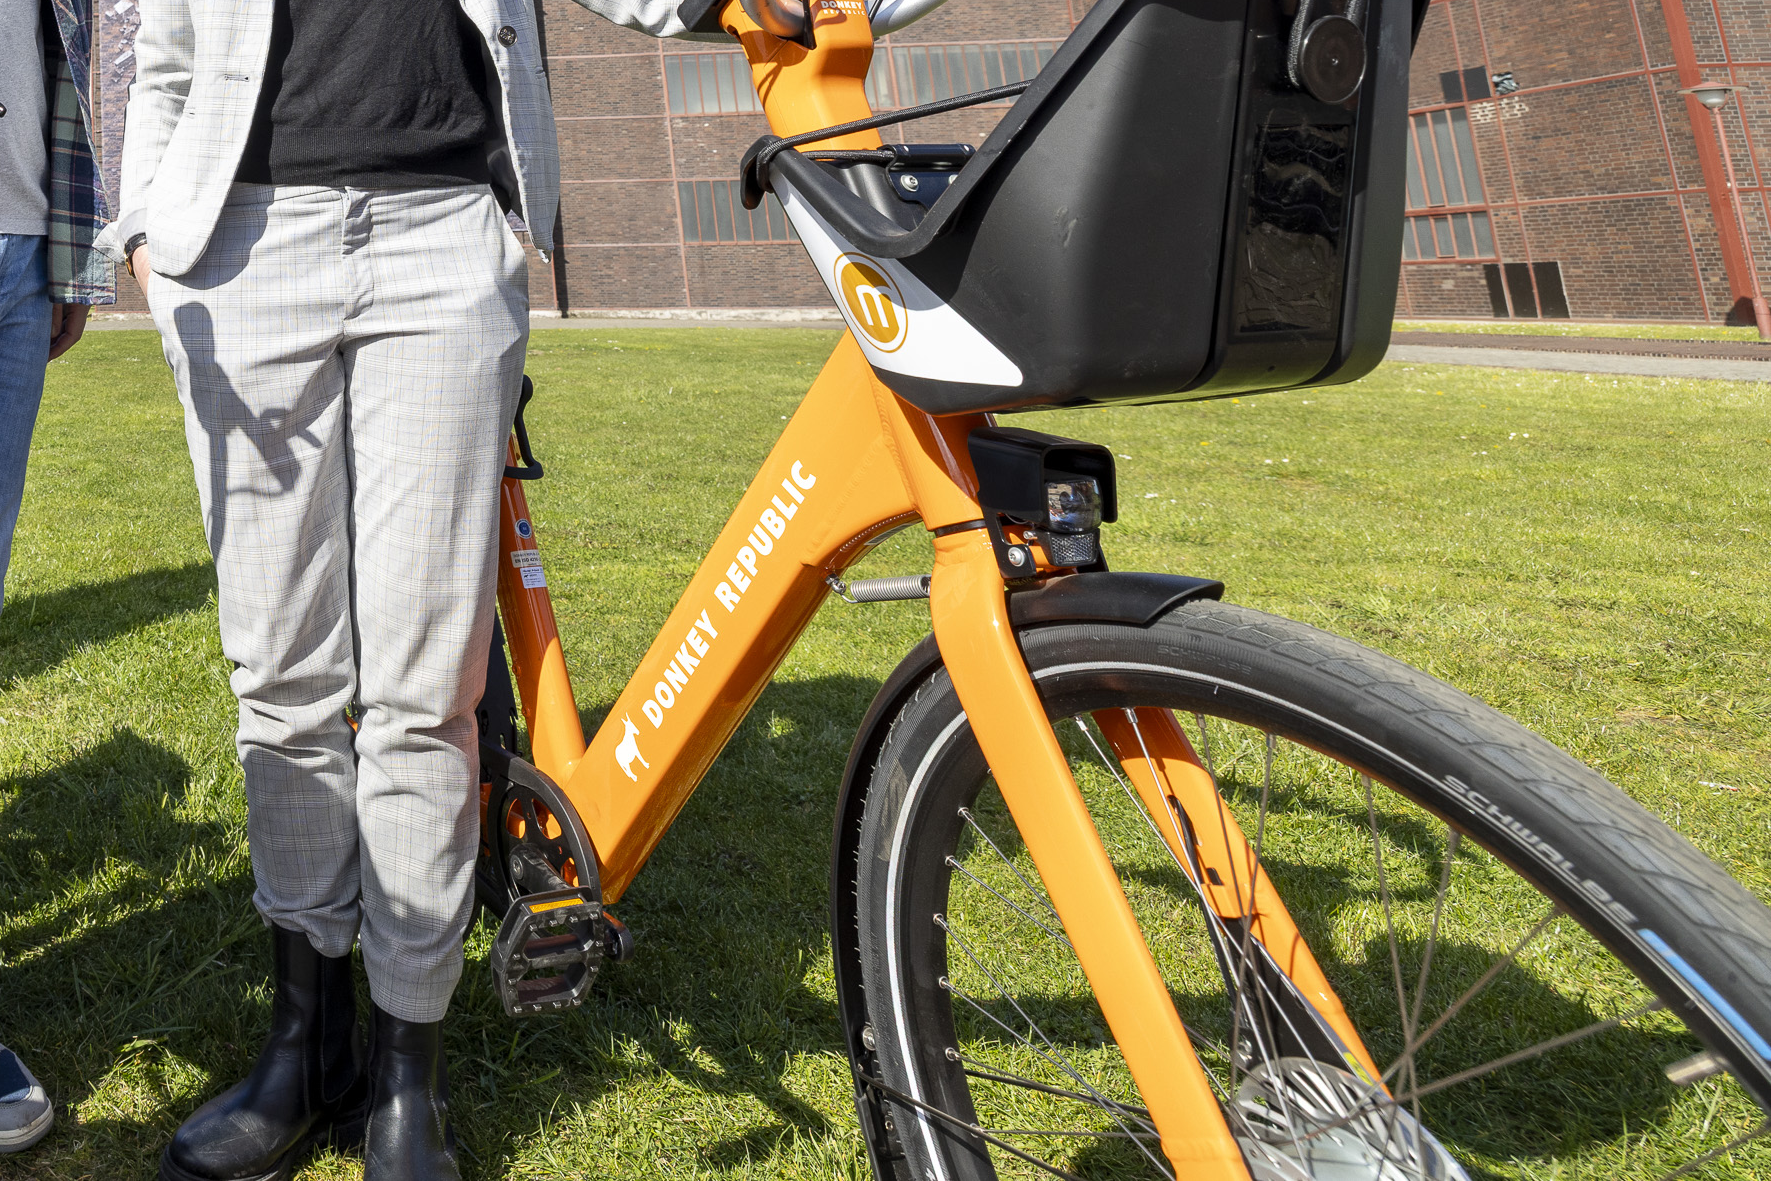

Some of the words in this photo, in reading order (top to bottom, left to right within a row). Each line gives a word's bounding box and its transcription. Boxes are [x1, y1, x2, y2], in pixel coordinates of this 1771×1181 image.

[820, 0, 862, 10] DONKEY
[641, 608, 719, 730] DONKEY
[713, 459, 817, 613] REPUBLIC
[1442, 774, 1639, 924] SCHWALBE
